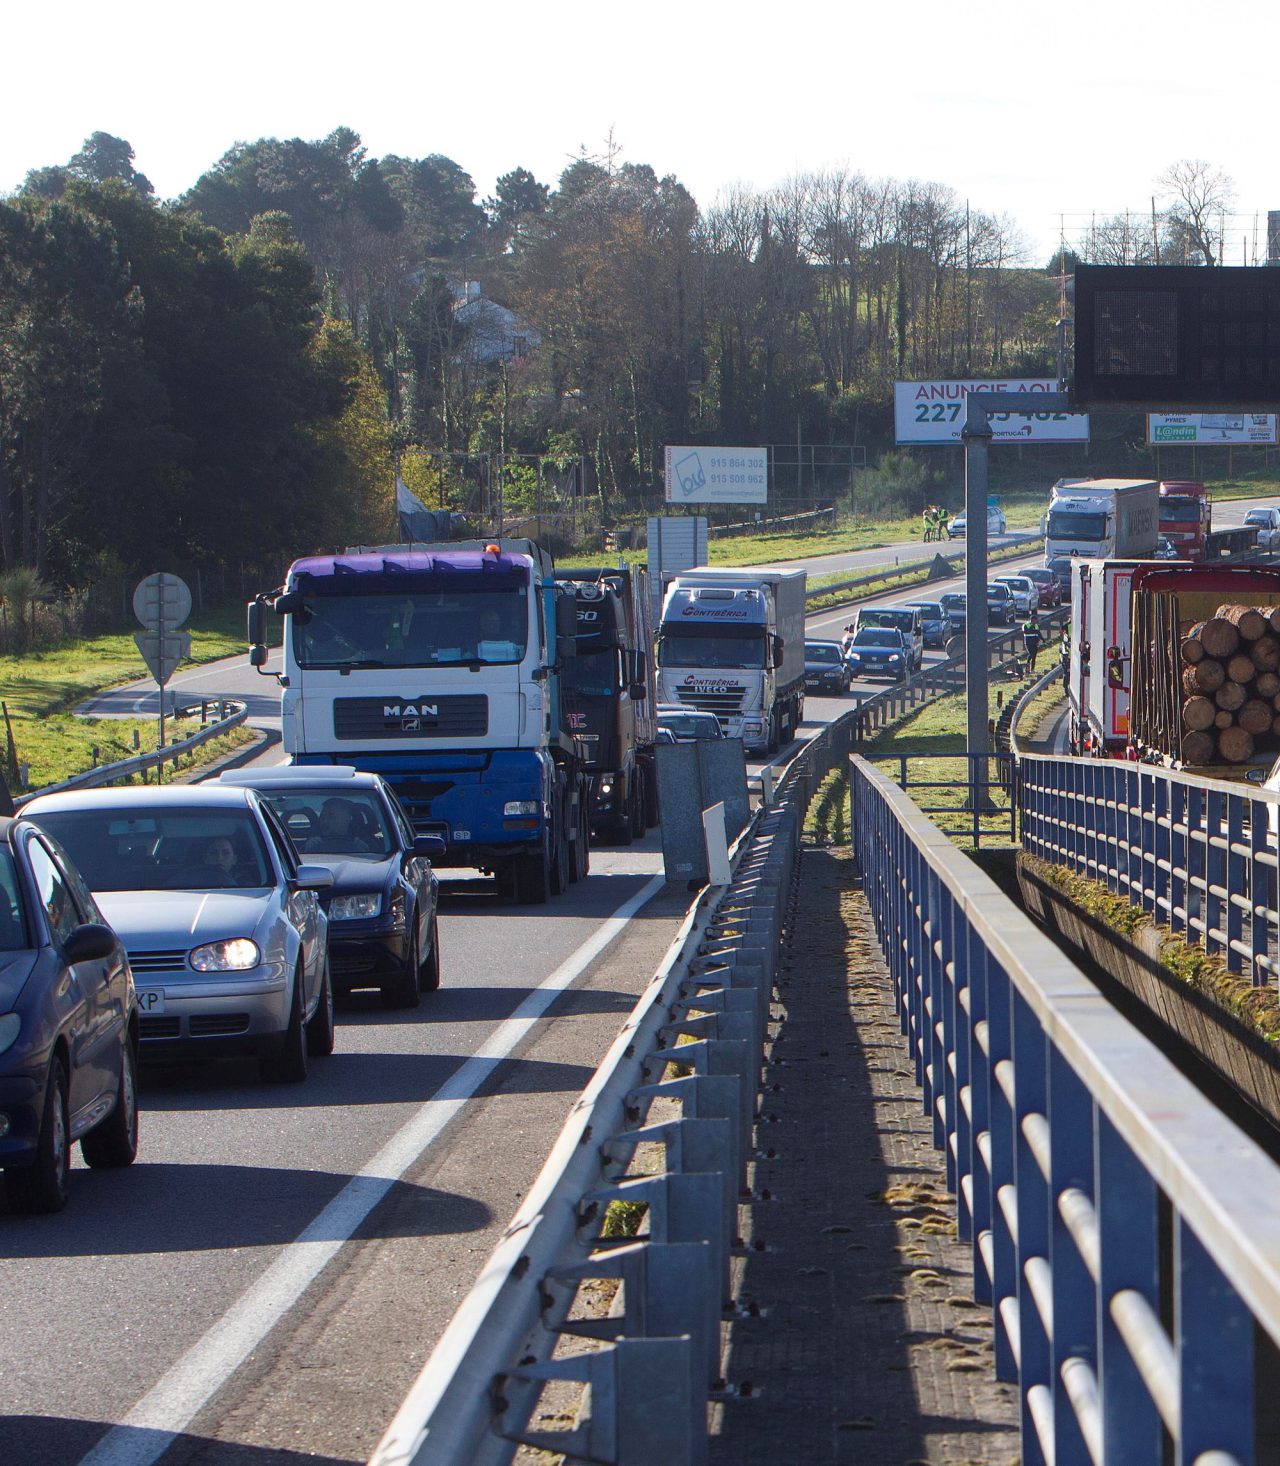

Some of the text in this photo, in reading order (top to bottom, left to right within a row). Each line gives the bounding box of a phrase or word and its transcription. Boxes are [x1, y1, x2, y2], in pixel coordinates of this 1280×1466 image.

[915, 403, 962, 423] 227
[1156, 426, 1195, 436] L@ndin
[383, 704, 438, 717] MAN
[455, 831, 471, 840] SP
